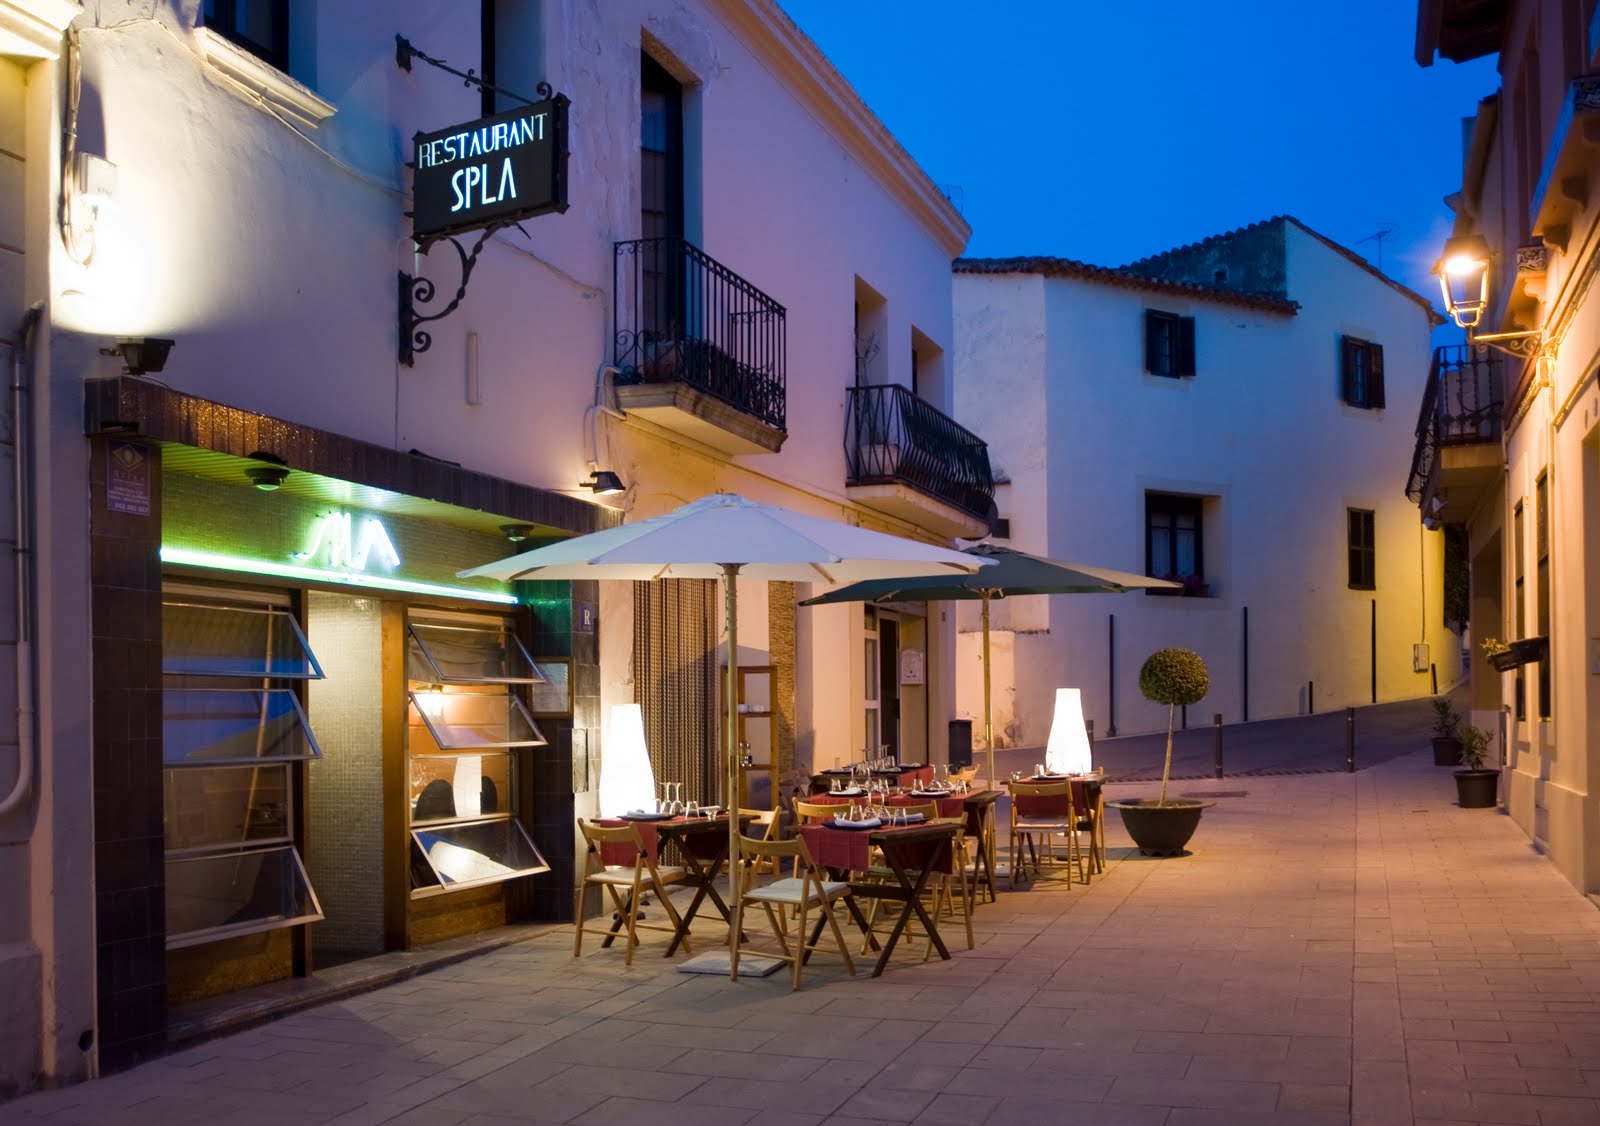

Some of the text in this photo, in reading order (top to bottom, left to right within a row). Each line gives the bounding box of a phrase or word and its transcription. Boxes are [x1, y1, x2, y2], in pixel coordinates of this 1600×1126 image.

[418, 112, 548, 169] RESTAURANT
[451, 157, 517, 212] SPLA
[584, 609, 592, 625] R
